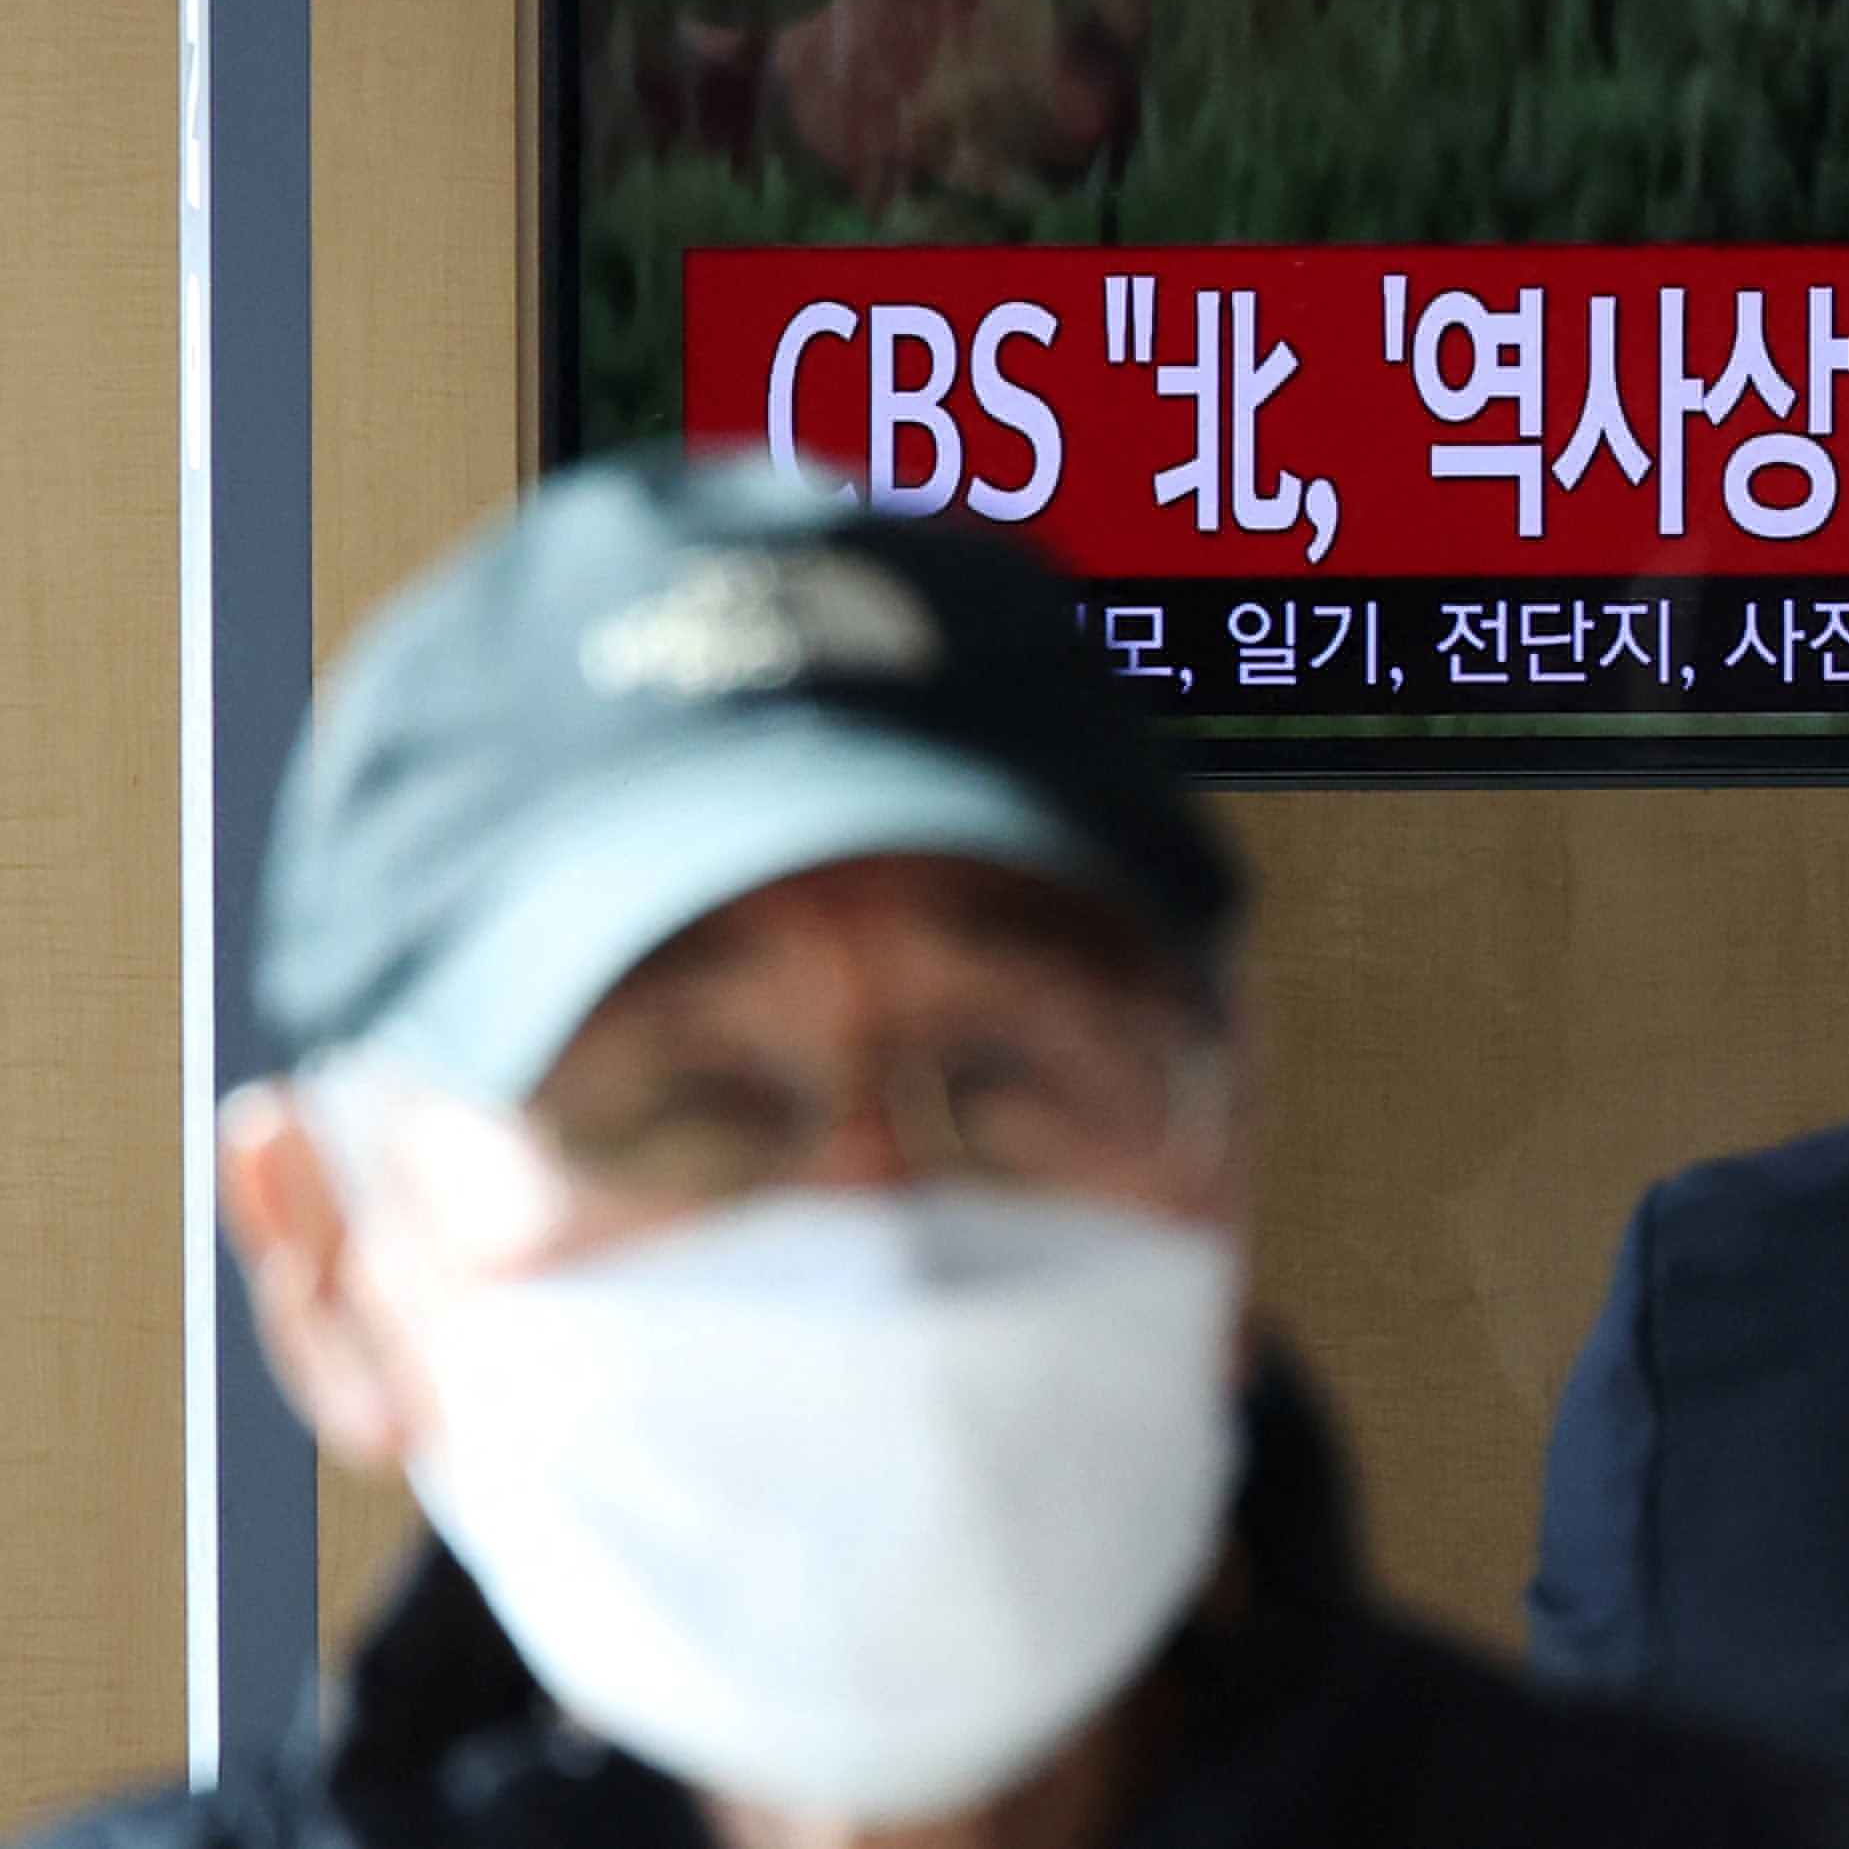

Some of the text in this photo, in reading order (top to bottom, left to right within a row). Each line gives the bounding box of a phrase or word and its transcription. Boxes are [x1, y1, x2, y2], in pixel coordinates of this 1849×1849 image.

[766, 300, 1063, 522] CBS
[1073, 601, 1194, 693] 모,
[1227, 601, 1406, 691] 일기,
[1436, 599, 1697, 690] 전단지,
